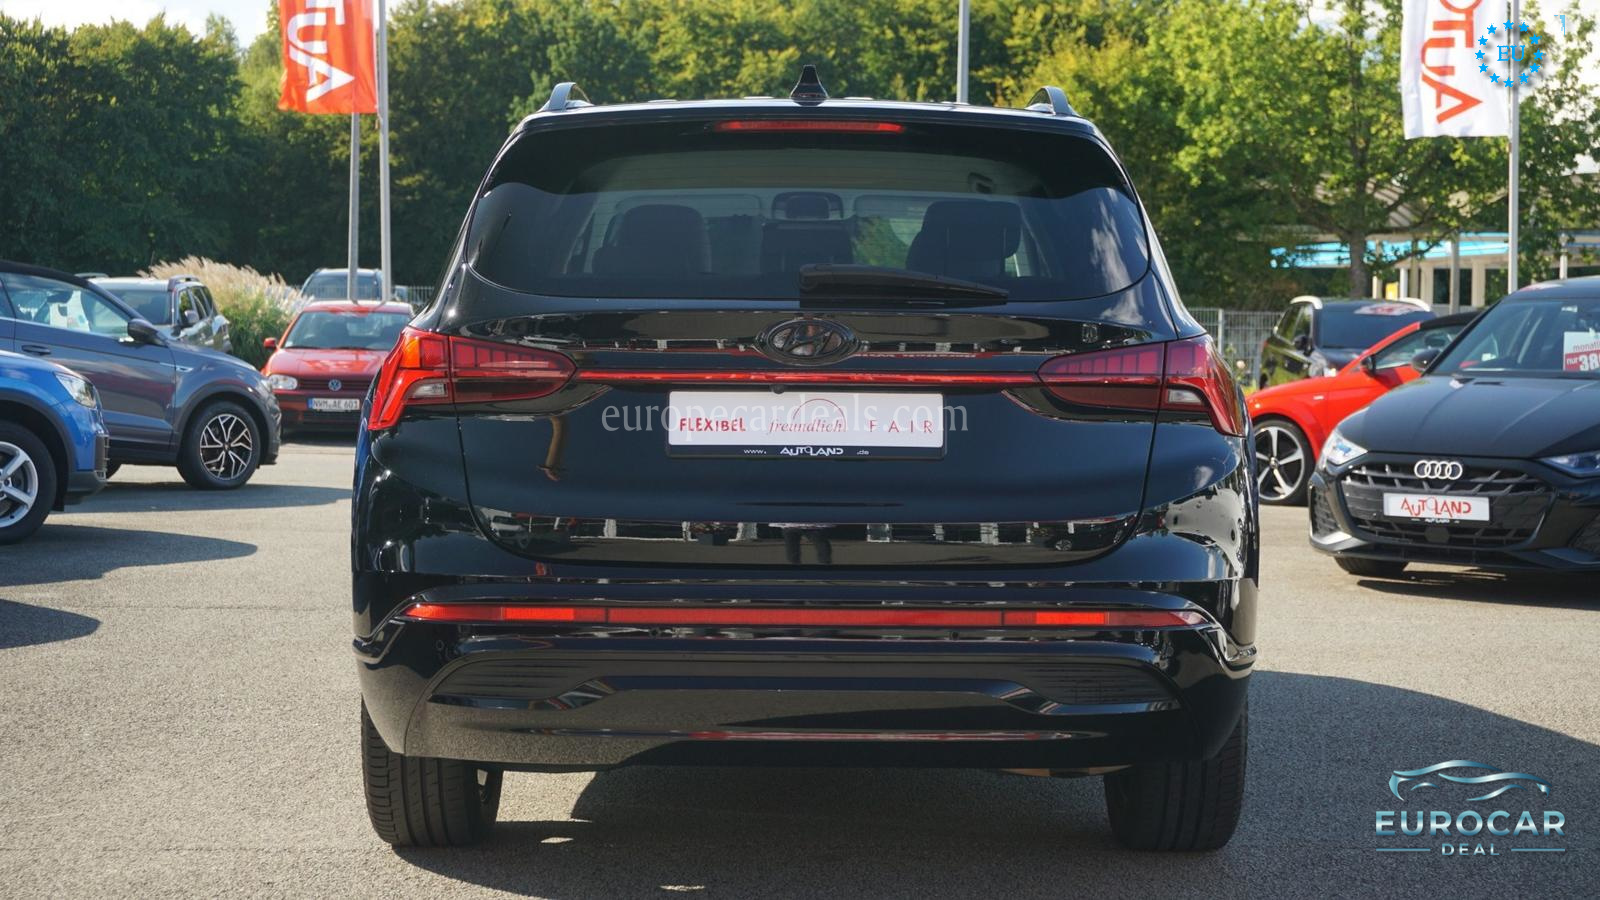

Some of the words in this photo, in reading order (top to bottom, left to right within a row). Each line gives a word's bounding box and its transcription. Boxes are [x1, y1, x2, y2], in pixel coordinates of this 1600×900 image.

[1579, 353, 1600, 371] 38
[680, 417, 746, 432] FLEXIBEL
[768, 418, 843, 434] freundlich
[780, 446, 844, 456] AUTOLAND
[1401, 497, 1472, 518] AUTOLAND
